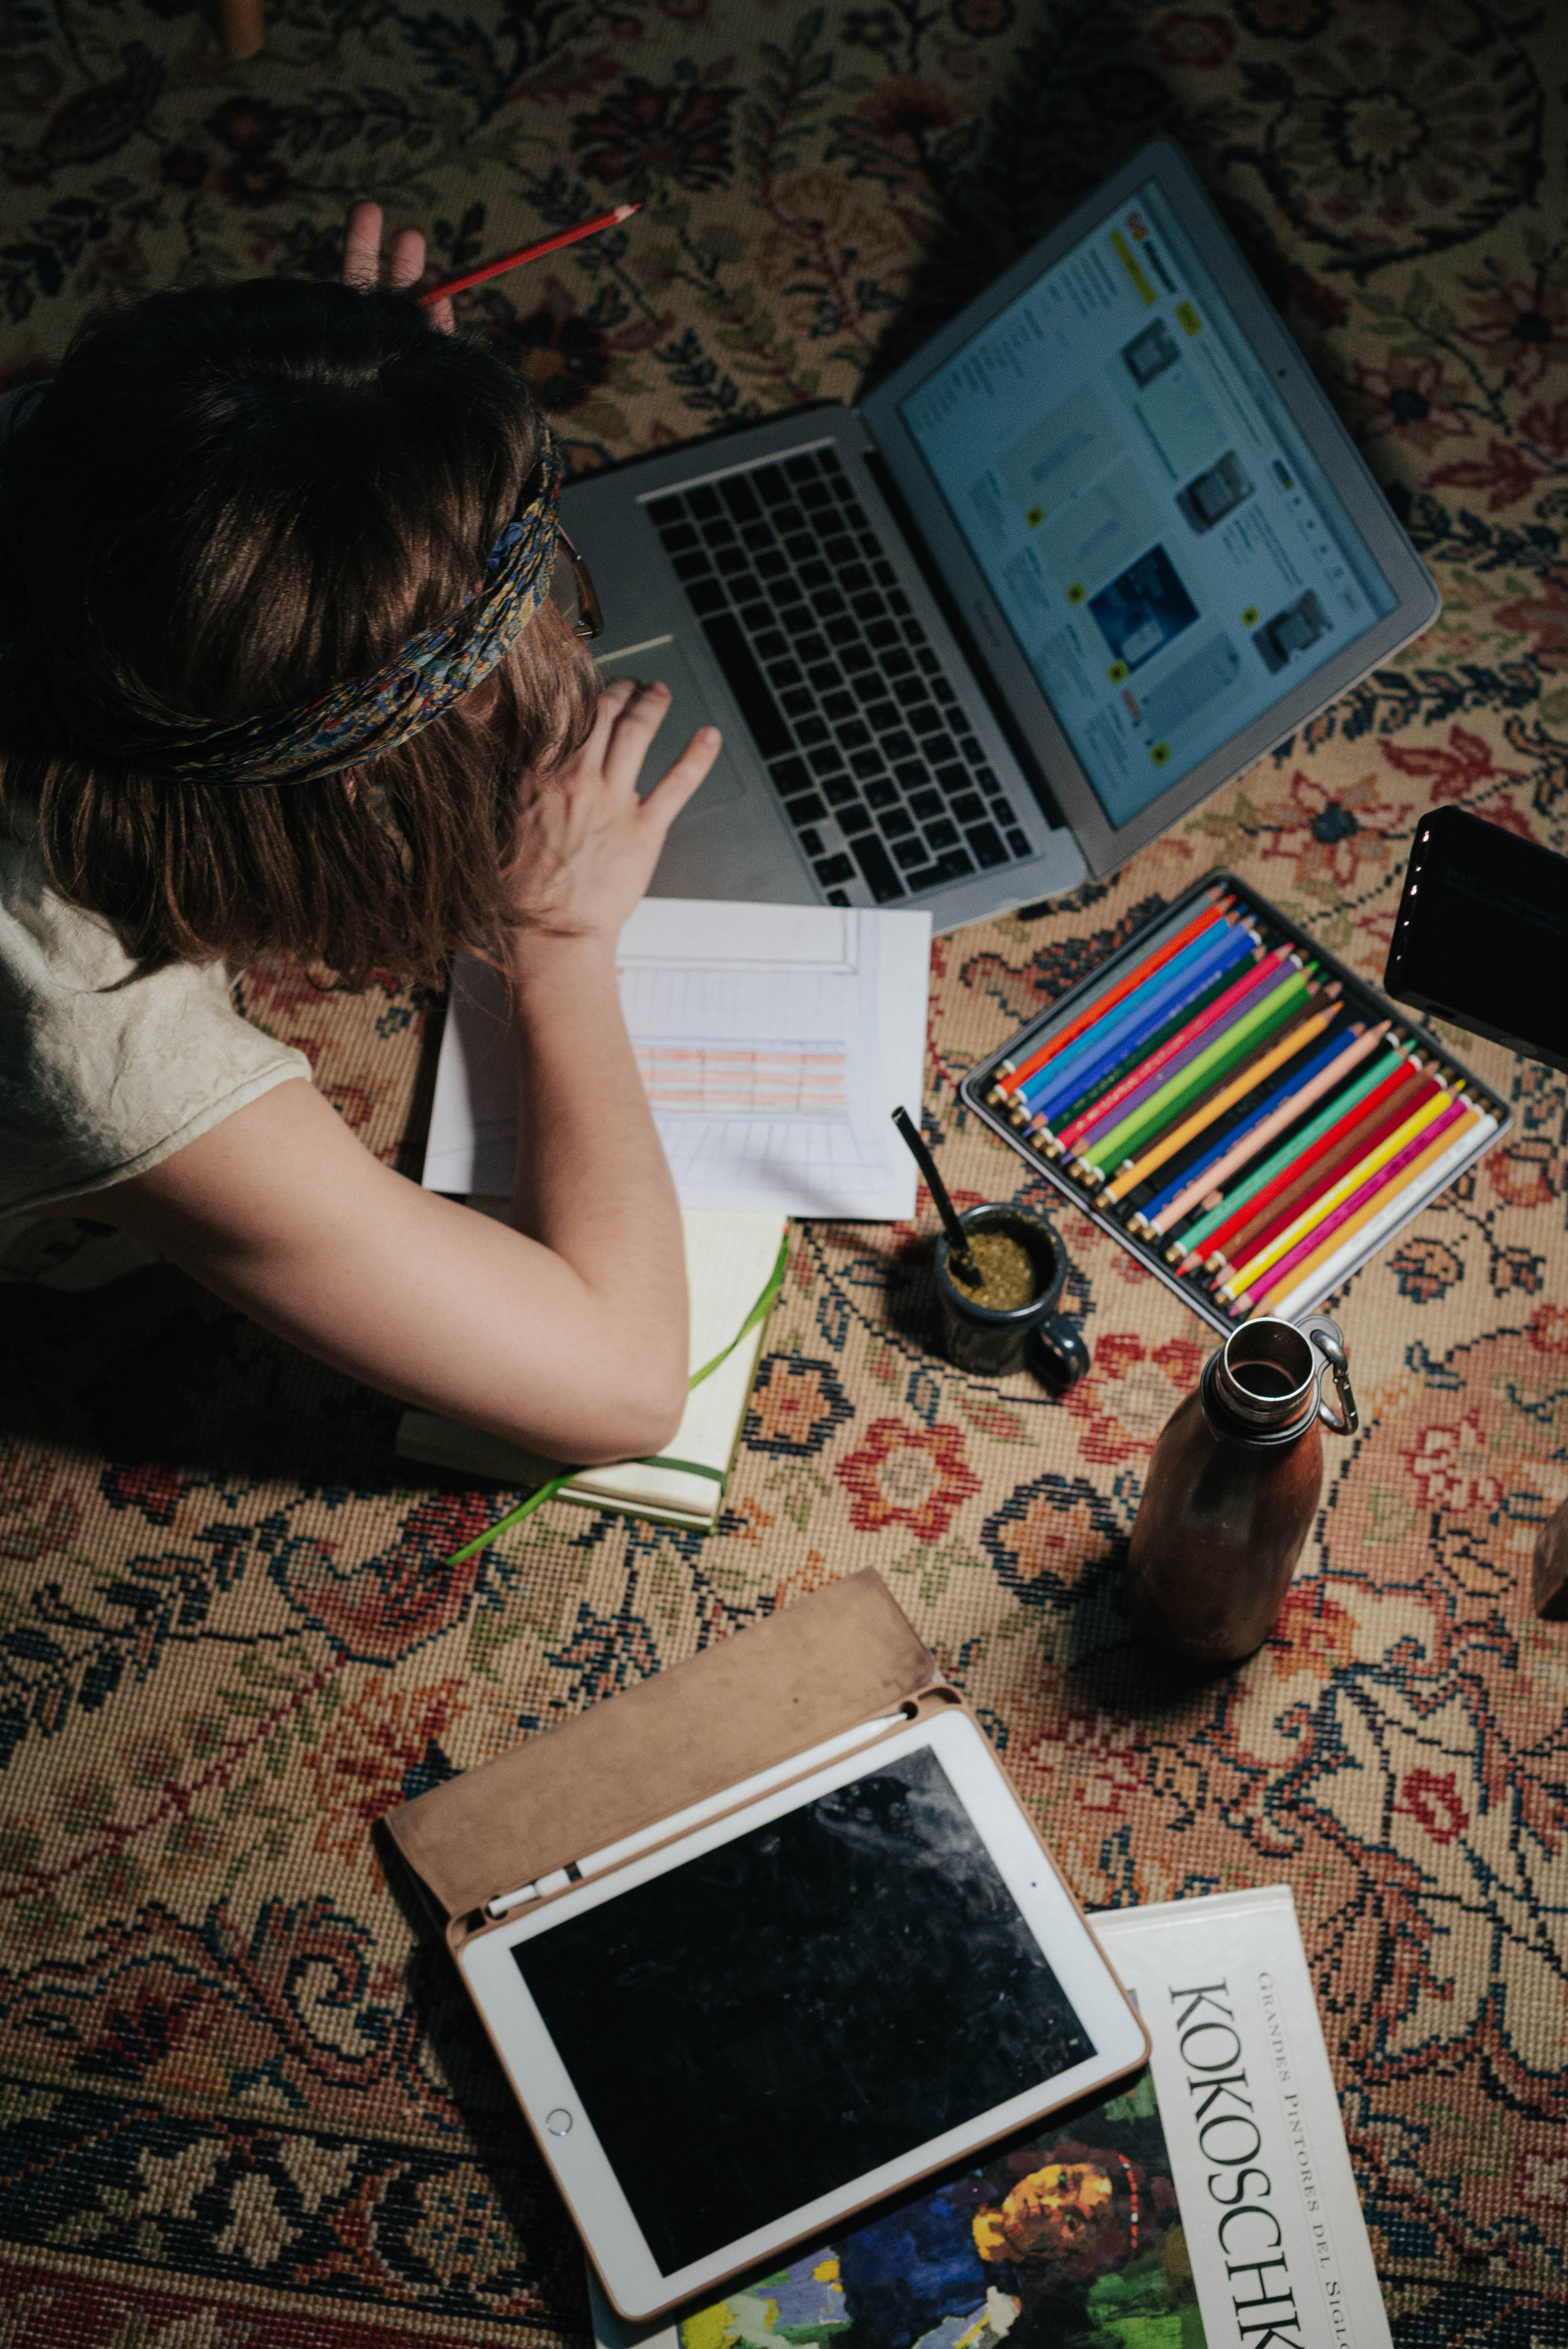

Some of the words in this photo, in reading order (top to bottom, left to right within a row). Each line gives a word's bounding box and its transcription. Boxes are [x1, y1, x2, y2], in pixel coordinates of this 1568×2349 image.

[1169, 1977, 1306, 2349] KOKOSCHK
[1259, 1972, 1291, 2082] GRANDES
[1285, 2093, 1319, 2212] PINTORES
[1313, 2224, 1330, 2269] DEL
